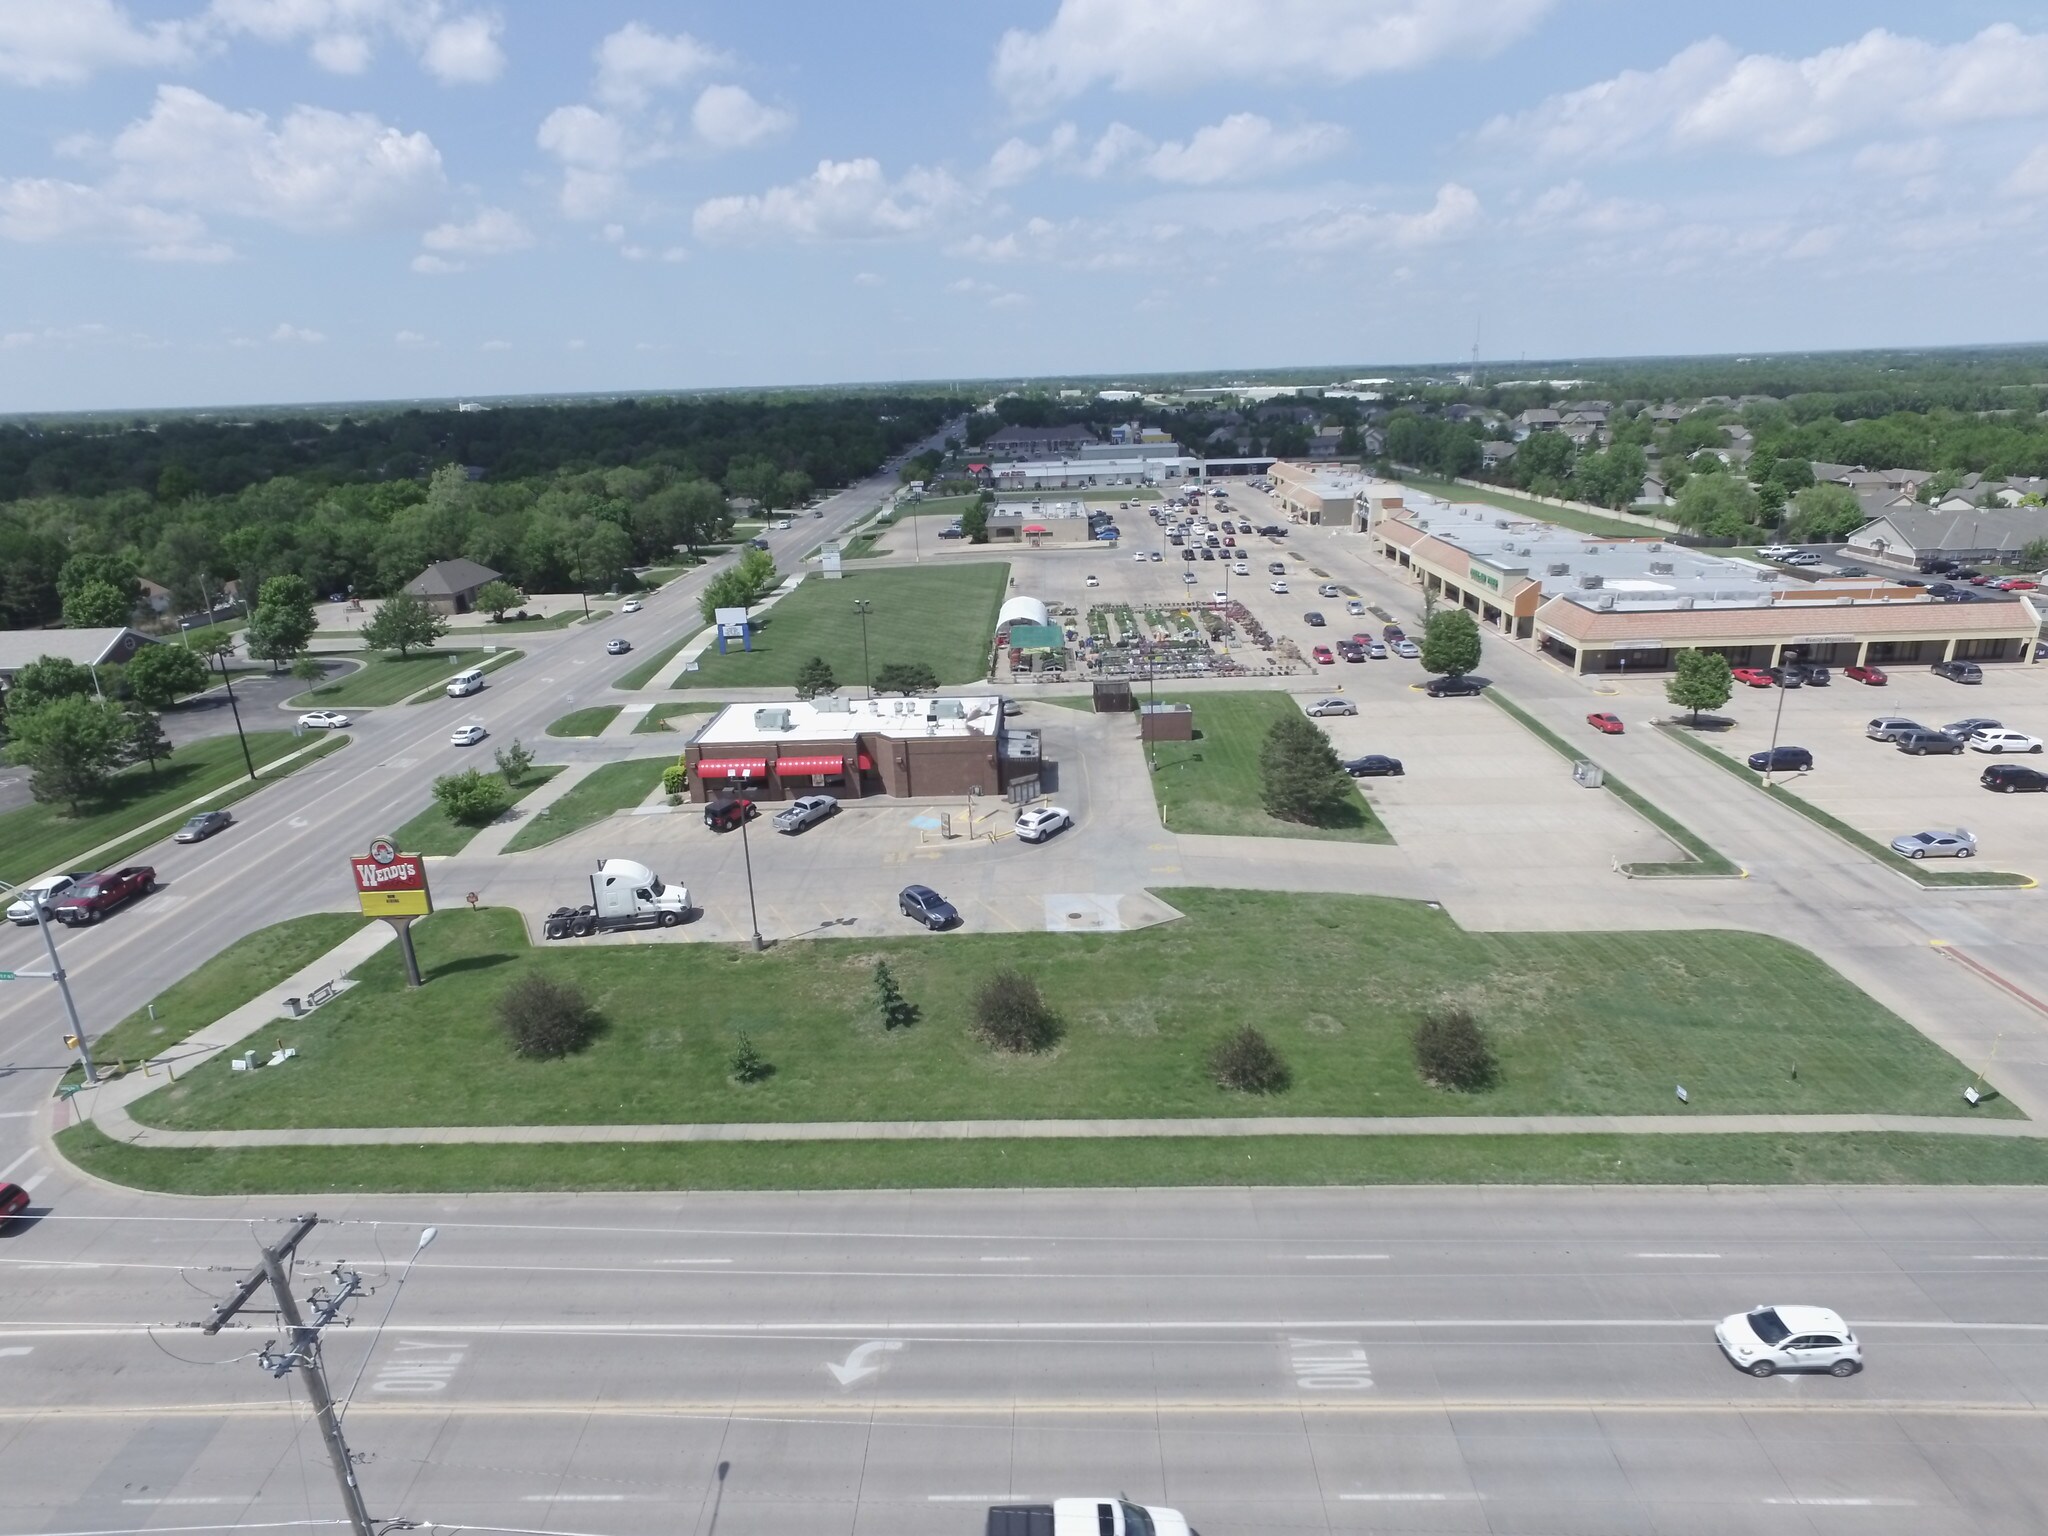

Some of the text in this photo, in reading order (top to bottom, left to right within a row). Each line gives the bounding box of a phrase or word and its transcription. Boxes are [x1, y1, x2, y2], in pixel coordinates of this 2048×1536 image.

[357, 863, 416, 887] Wendy's
[372, 1341, 468, 1391] ONLY
[1288, 1338, 1374, 1388] ONLY
